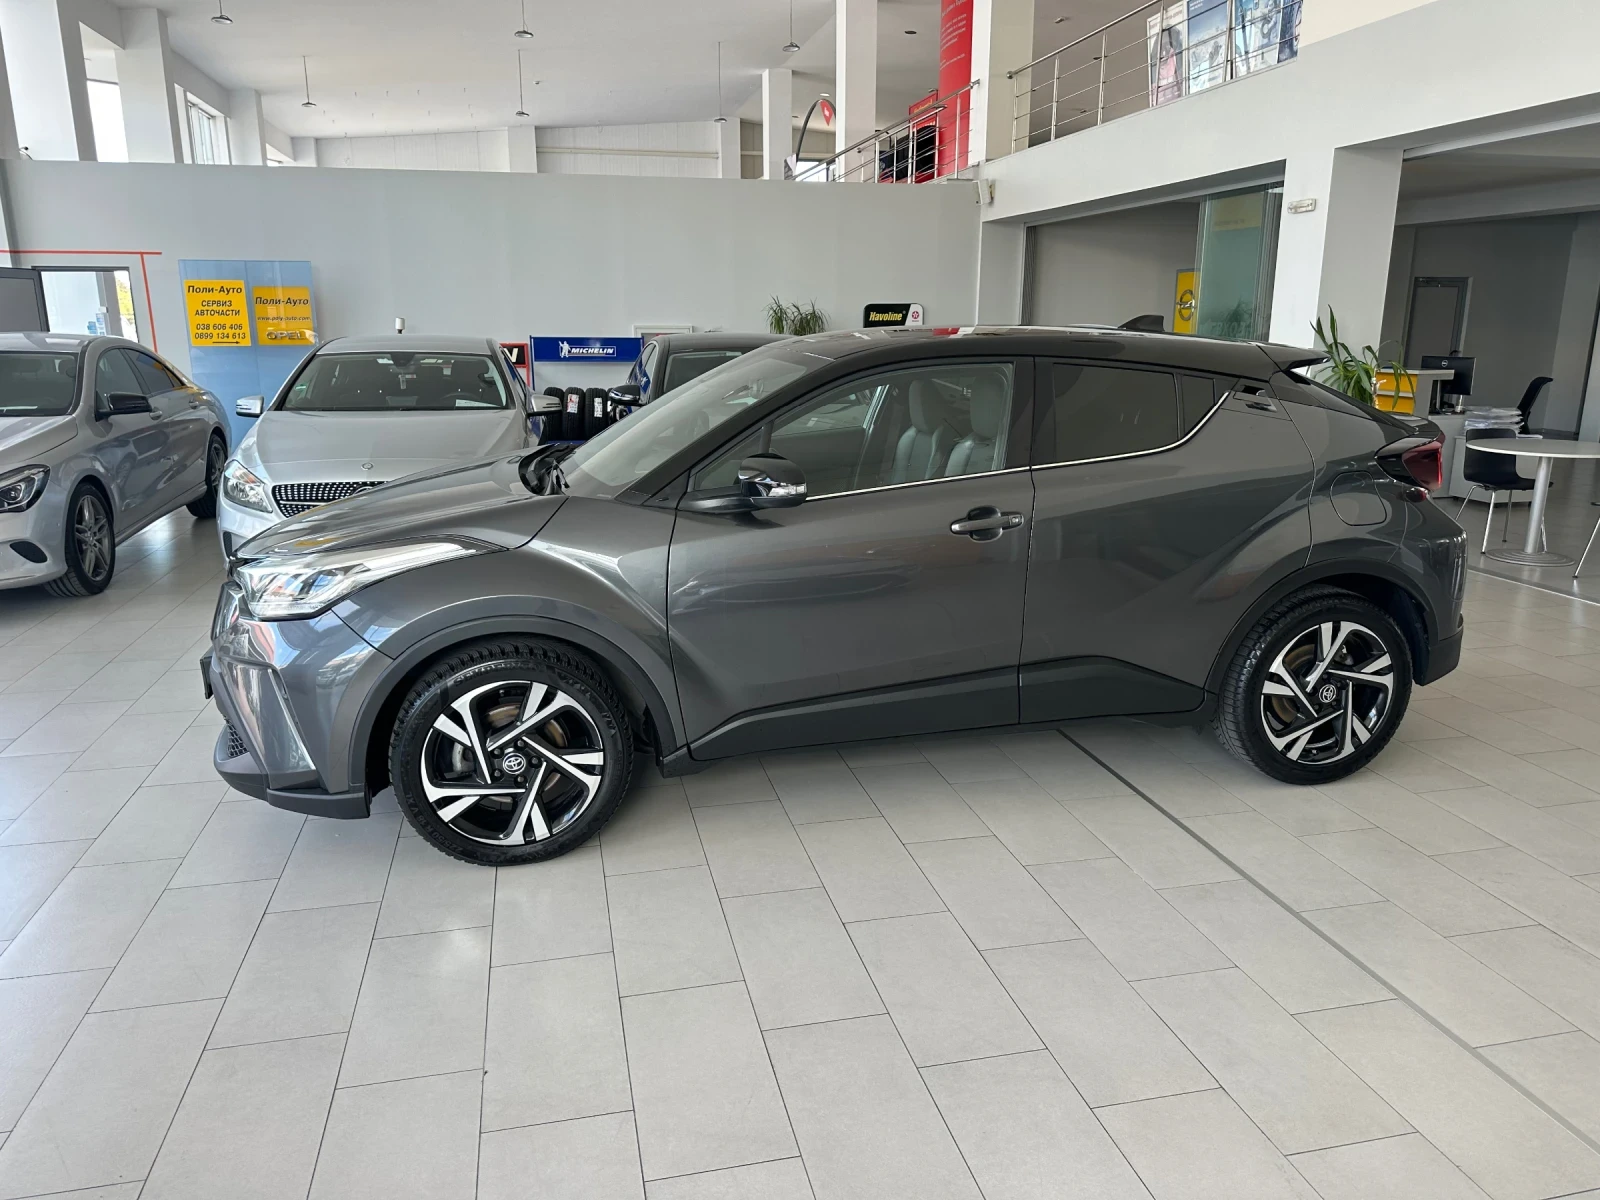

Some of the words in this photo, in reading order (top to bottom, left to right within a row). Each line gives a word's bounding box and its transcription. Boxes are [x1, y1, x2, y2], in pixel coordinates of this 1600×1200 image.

[187, 285, 243, 295] Поли-Ауто
[255, 297, 309, 307] Поли-Ауто
[869, 312, 902, 321] Havoline
[266, 330, 307, 340] OPEL
